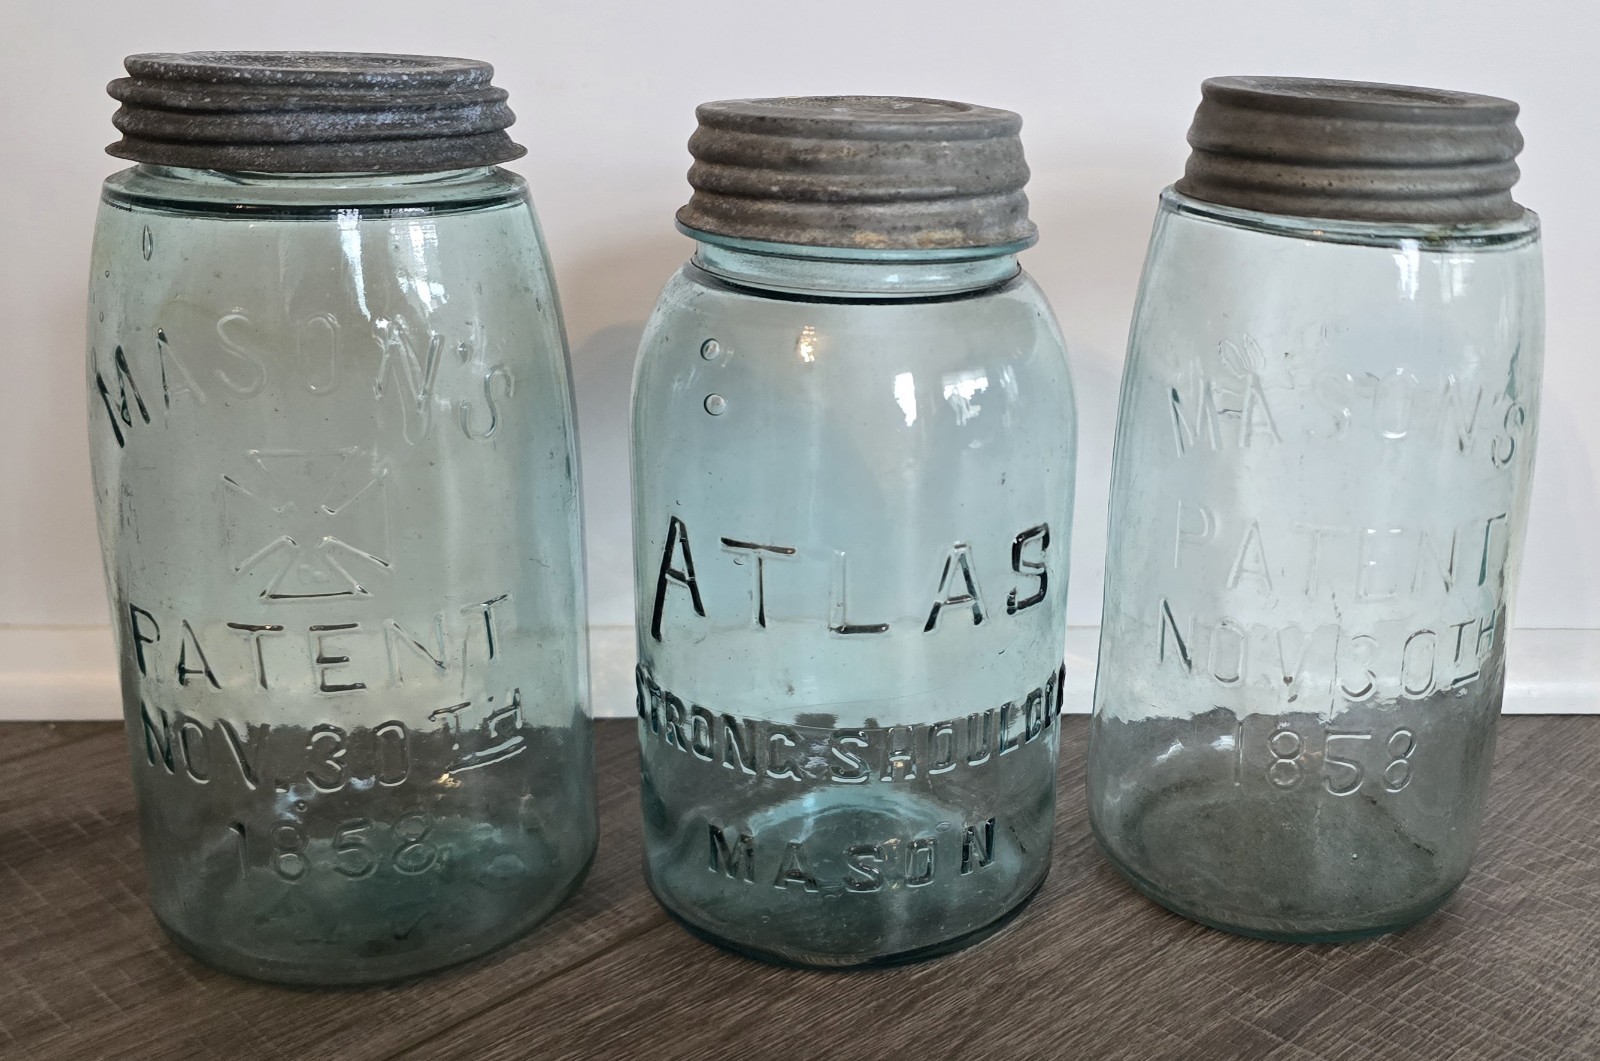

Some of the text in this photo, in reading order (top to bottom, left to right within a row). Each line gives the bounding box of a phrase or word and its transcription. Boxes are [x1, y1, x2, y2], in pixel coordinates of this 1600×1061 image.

[95, 312, 515, 449] MASON'S
[650, 515, 1051, 642] ATLAS
[1173, 499, 1508, 602] PATENT
[129, 594, 509, 693] PATENT
[1233, 720, 1418, 797] 1858
[228, 811, 439, 884] 1858
[708, 816, 998, 894] MASON
